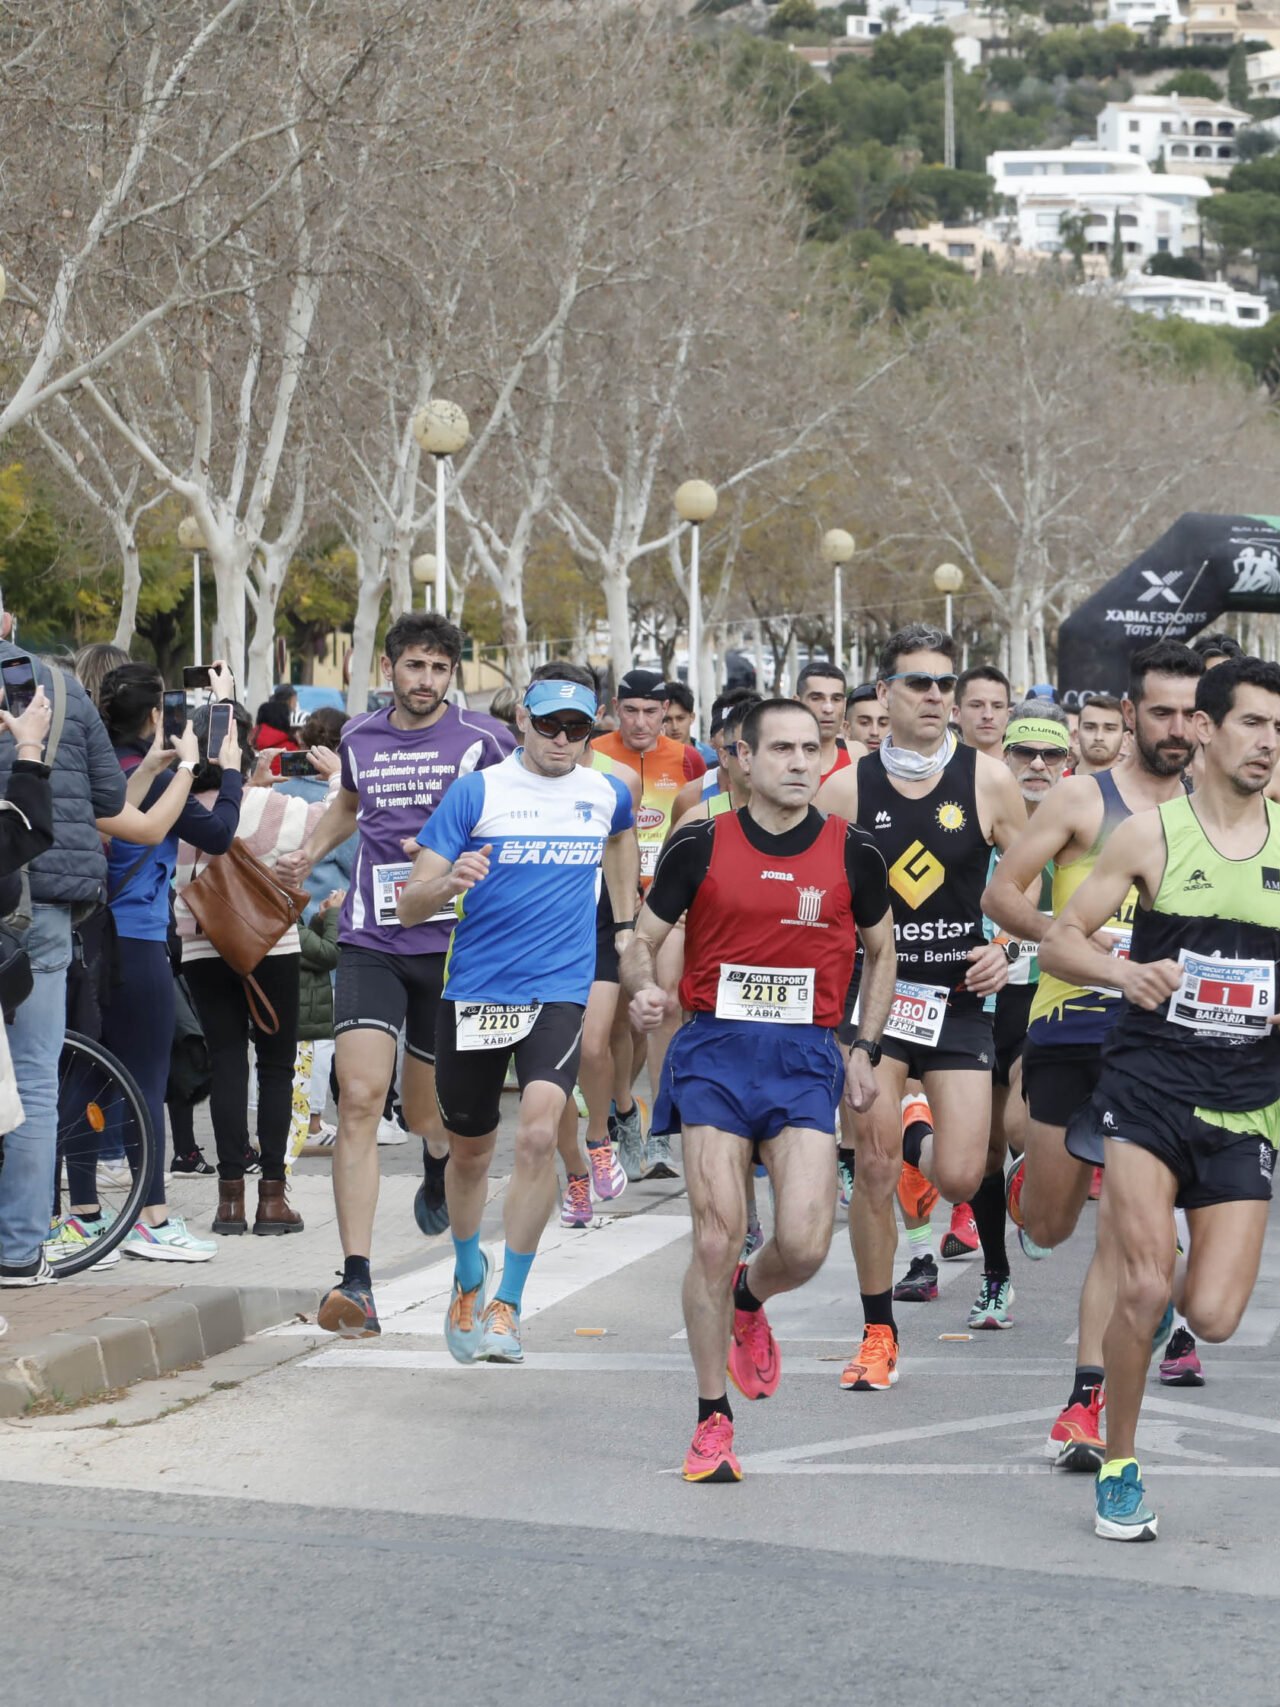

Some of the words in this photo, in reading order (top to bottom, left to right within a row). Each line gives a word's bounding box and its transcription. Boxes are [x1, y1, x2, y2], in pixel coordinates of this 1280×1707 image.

[1124, 624, 1152, 637] TOTS
[366, 767, 380, 778] cada
[418, 766, 430, 776] que
[431, 764, 455, 777] supere
[367, 785, 375, 794] en
[375, 782, 382, 793] la
[382, 783, 407, 793] carrera
[408, 779, 416, 791] de
[417, 779, 424, 790] la
[376, 797, 387, 808] Per
[388, 796, 413, 808] sempre
[414, 794, 432, 806] JOAN
[503, 840, 547, 849] CLUB
[498, 849, 603, 865] GANDIA
[893, 919, 975, 941] nestar
[750, 974, 771, 983] SOM
[773, 975, 805, 985] ESPORT
[742, 984, 787, 1002] 2218
[1222, 987, 1230, 1005] 1
[1259, 989, 1268, 1005] B
[506, 1004, 535, 1012] ESPOR
[927, 1007, 938, 1020] D
[479, 1014, 519, 1030] 2220
[1195, 1010, 1246, 1024] BALEARIA
